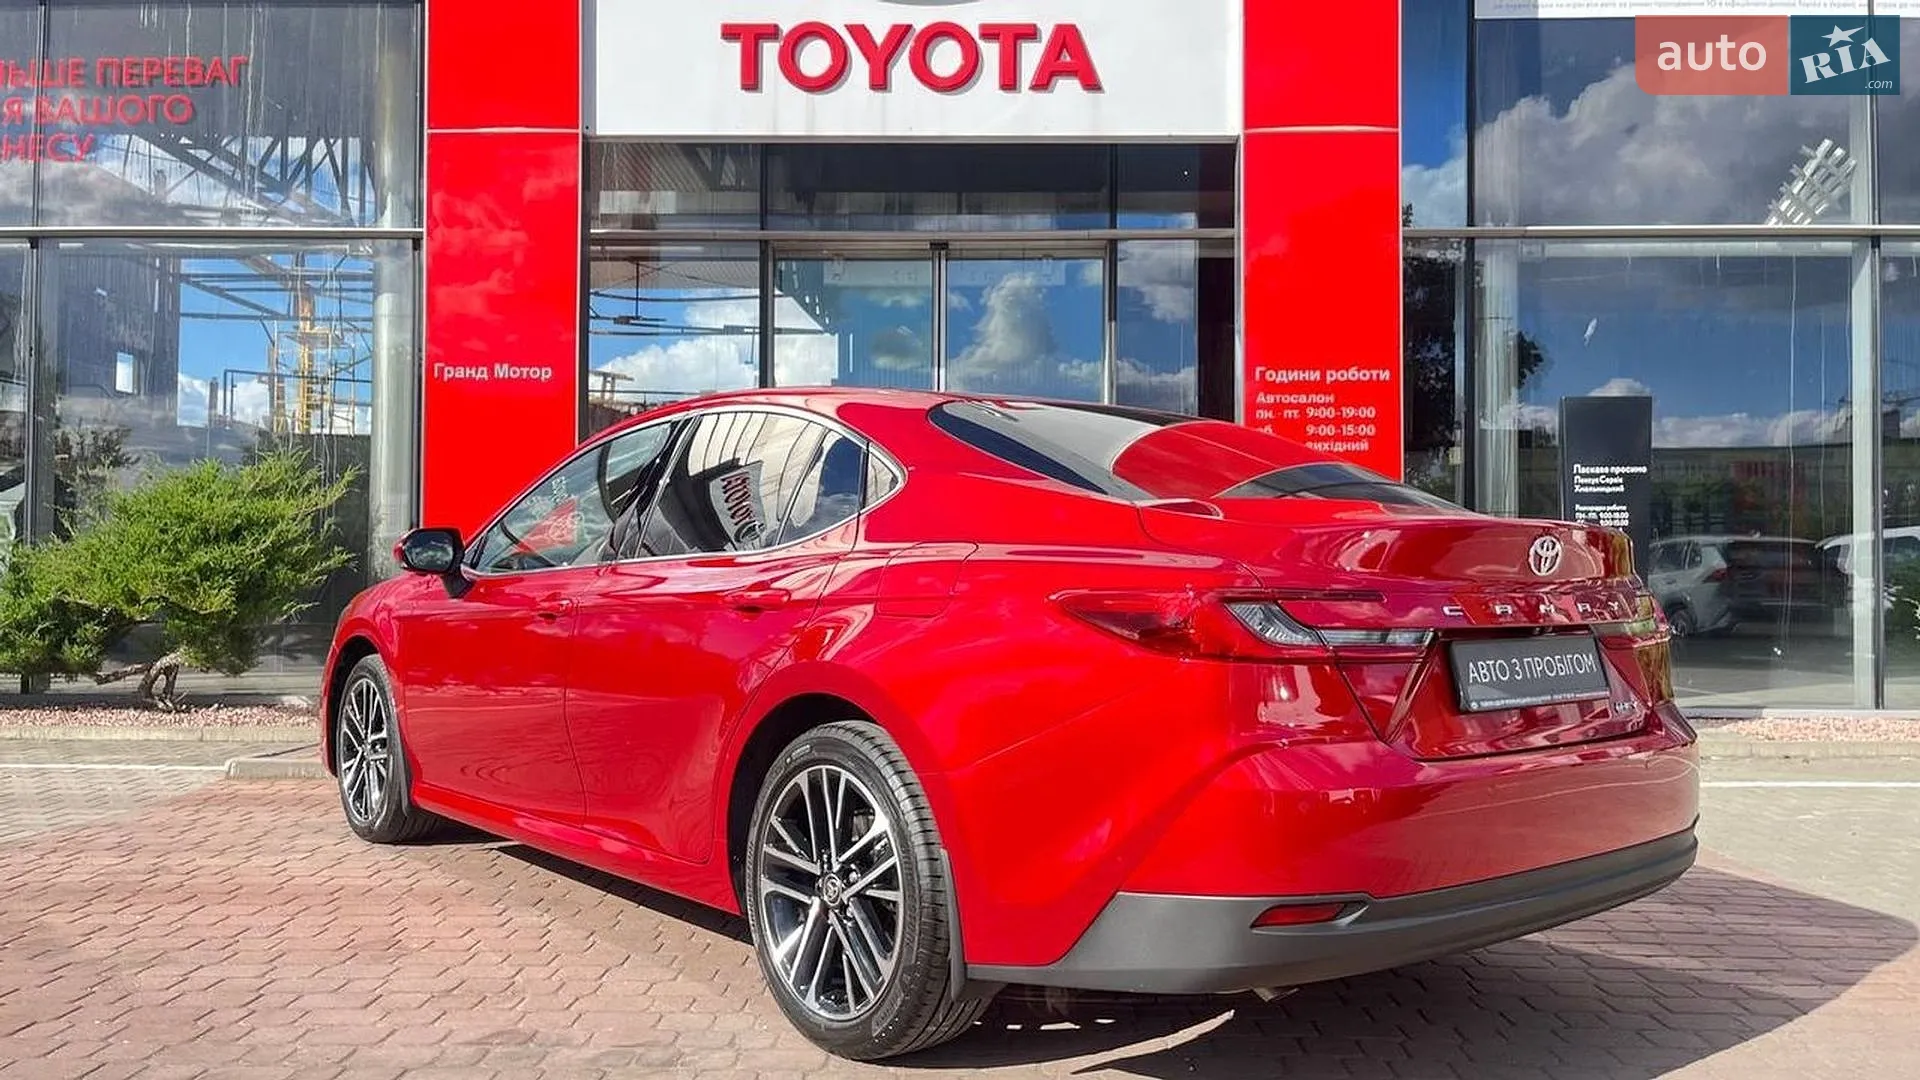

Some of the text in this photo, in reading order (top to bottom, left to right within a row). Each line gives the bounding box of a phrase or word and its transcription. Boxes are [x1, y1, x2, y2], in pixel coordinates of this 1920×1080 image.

[720, 21, 1104, 93] TOYOTA
[96, 55, 248, 88] ПЕРЕВАГ
[34, 93, 194, 126] ВАШОГО
[433, 362, 553, 382] Гранд Мотор
[1255, 366, 1391, 384] Години роботи
[1256, 391, 1335, 404] Автосалон
[1306, 406, 1376, 419] 9:00-19:00
[1306, 424, 1376, 436] 9:00-15:00
[1443, 601, 1619, 616] CAMRY
[1469, 660, 1509, 683] АВТО
[1523, 653, 1597, 680] ПРОБІГОМ
